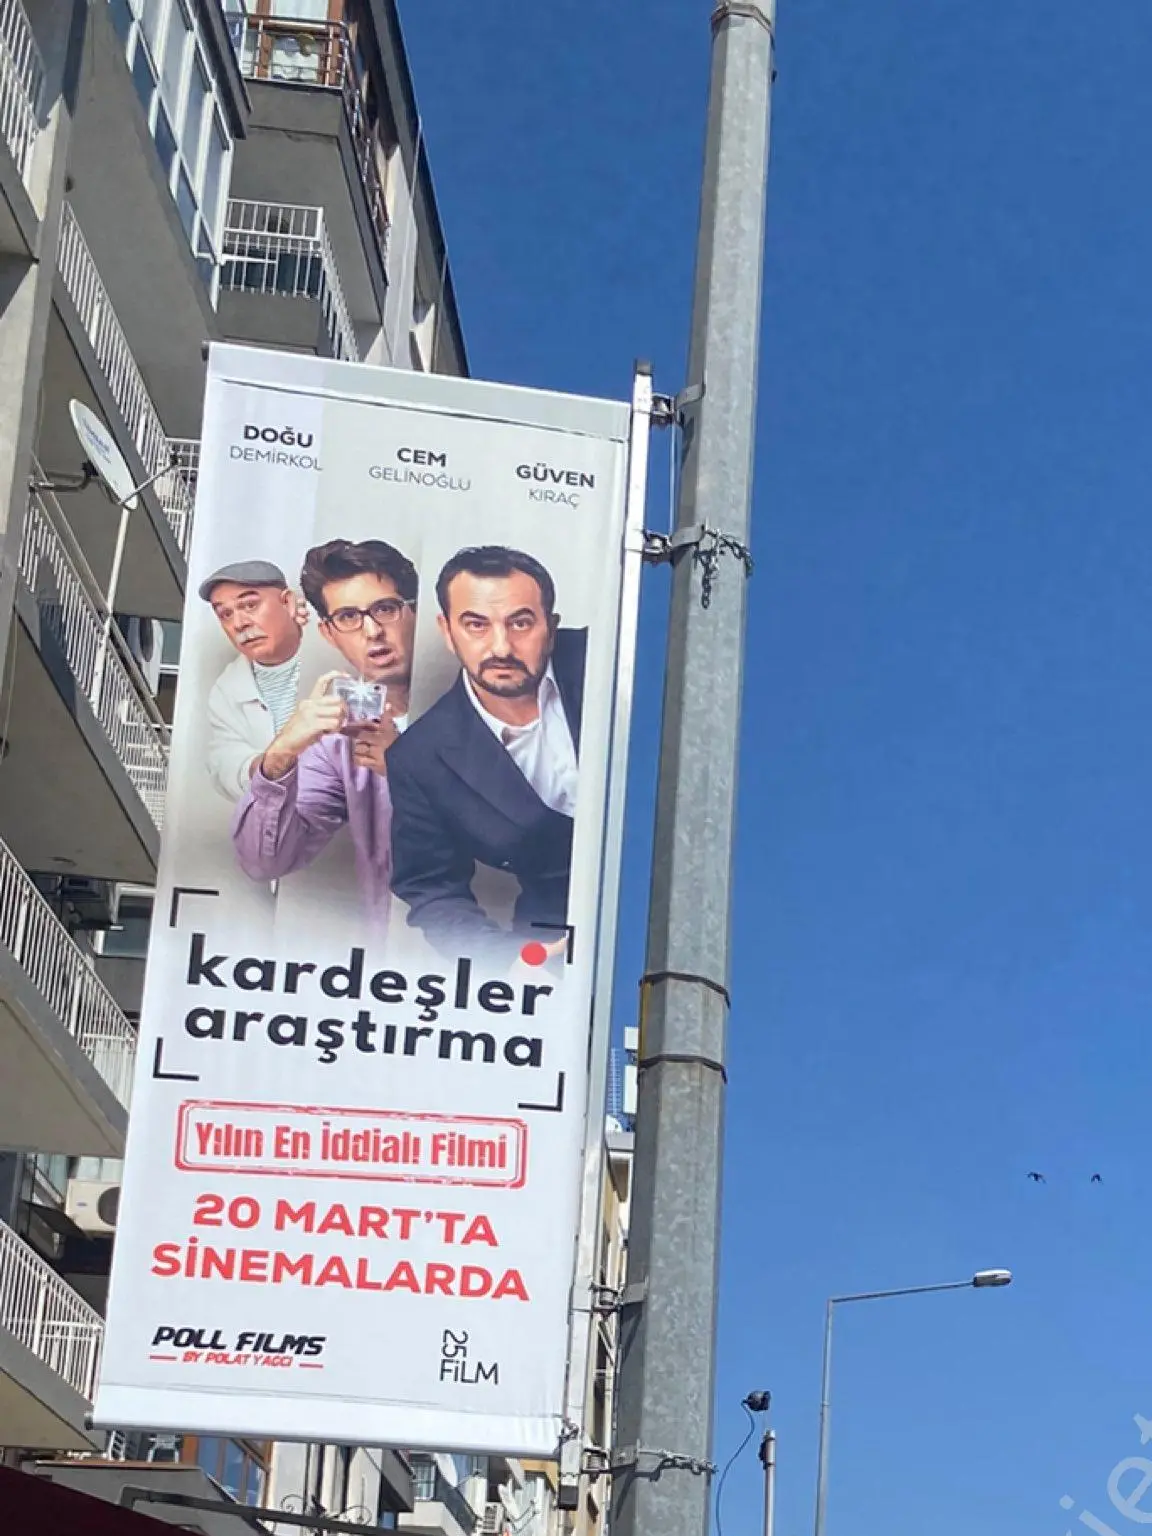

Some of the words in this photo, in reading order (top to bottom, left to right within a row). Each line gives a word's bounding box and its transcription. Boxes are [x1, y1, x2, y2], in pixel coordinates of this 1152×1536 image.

[243, 425, 313, 449] DOĞU
[229, 445, 323, 471] DEMİRKOL
[396, 447, 447, 468] CEM
[368, 465, 471, 492] GELİNOĞLU
[515, 463, 595, 488] GÜVEN
[527, 488, 581, 508] KIRAÇ
[186, 932, 554, 1022] kardeşler
[184, 1006, 544, 1067] araştırma
[195, 1122, 264, 1158] Yılın
[274, 1125, 311, 1160] En
[320, 1121, 422, 1165] İddialı
[431, 1131, 507, 1169] Filmi
[193, 1193, 261, 1229] 20
[274, 1199, 499, 1247] MART'TA
[150, 1236, 530, 1302] SİNEMALARDA
[151, 1326, 227, 1351] POLL
[235, 1331, 326, 1356] FILMS
[182, 1351, 203, 1363] BY
[205, 1352, 251, 1366] POLAT
